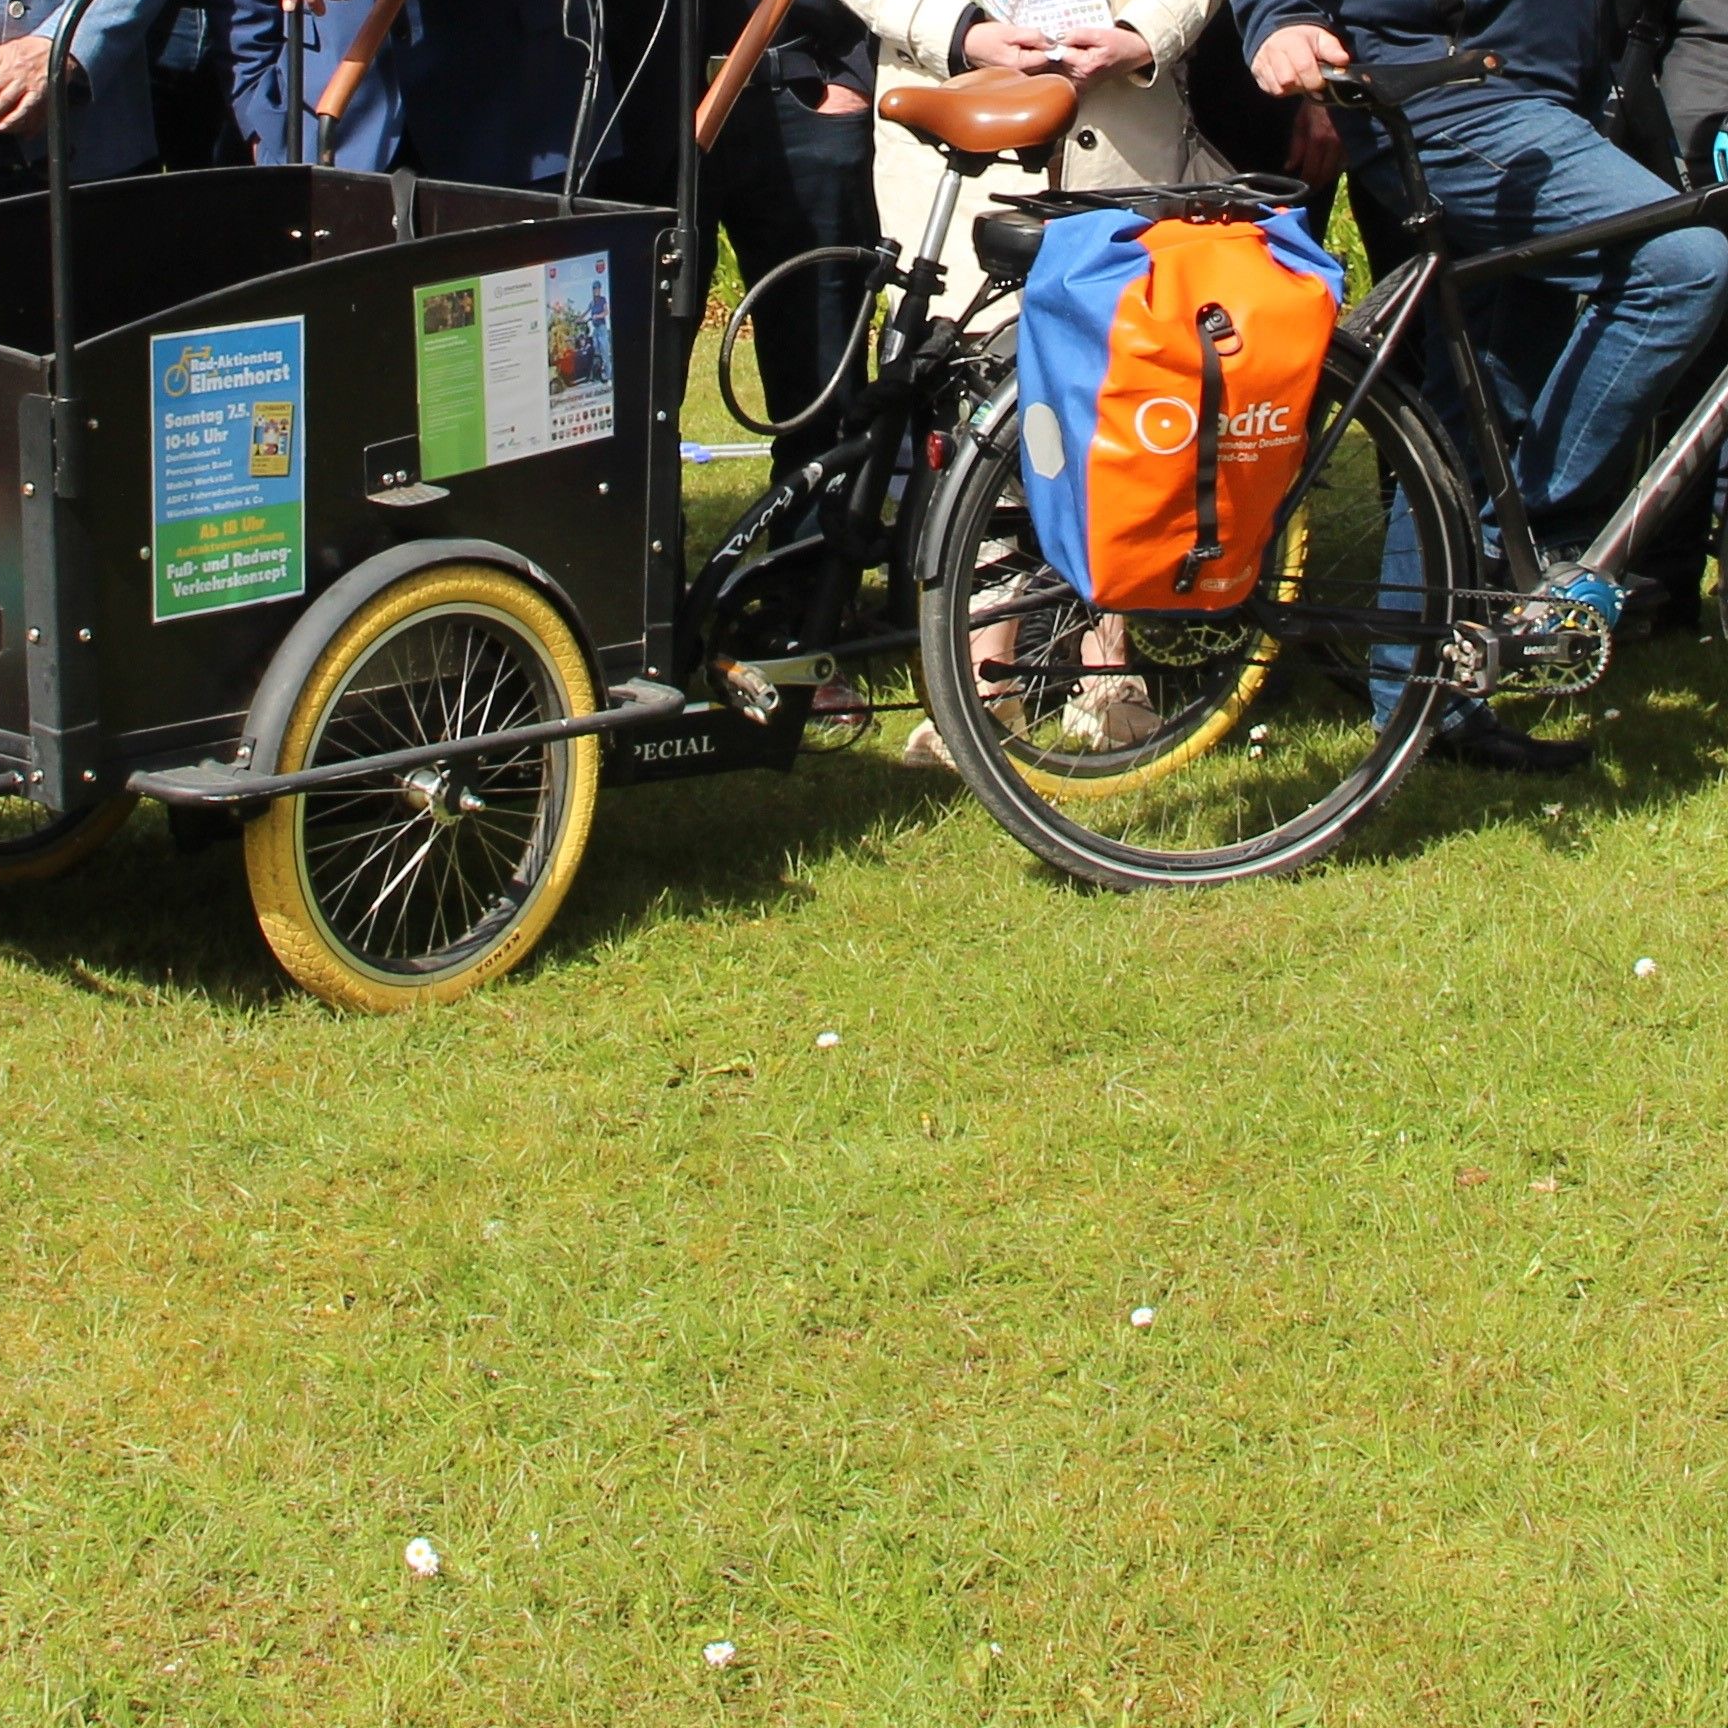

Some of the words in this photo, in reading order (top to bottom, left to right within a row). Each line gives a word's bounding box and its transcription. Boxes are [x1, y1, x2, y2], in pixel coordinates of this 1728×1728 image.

[190, 350, 283, 372] Rad-Aktionstag
[190, 363, 290, 394] Elmenhorst
[164, 409, 223, 429] Sonntag
[227, 403, 251, 420] 7.5.
[165, 431, 200, 450] 10-16
[204, 427, 229, 444] Uhr
[212, 459, 232, 469] Band
[199, 522, 219, 540] Ab
[241, 515, 266, 532] Uhr
[166, 560, 198, 580] Fuß-
[202, 553, 230, 573] und
[232, 547, 292, 568] Radweg-
[173, 564, 288, 598] Verkehrskonzept
